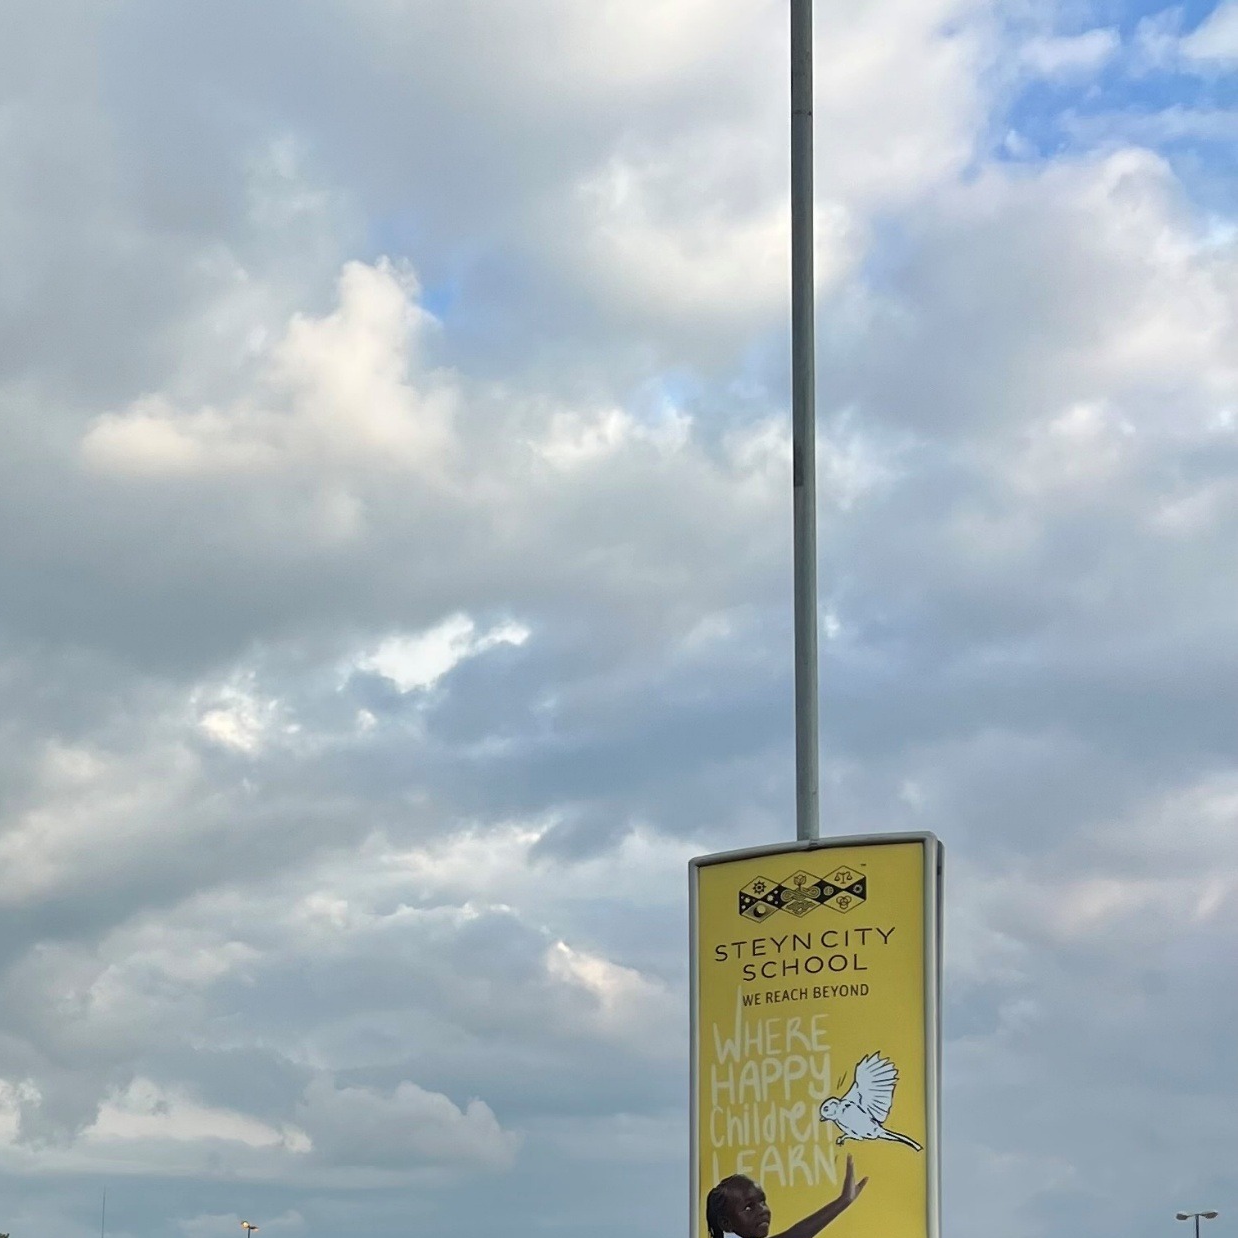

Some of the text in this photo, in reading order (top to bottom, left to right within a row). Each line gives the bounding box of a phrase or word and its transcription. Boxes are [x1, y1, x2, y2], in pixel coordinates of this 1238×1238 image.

[715, 926, 896, 962] STEYN CITY
[742, 953, 868, 982] SCHOOL
[743, 983, 870, 1007] WE REACH BEYOND
[712, 985, 832, 1065] WHERE
